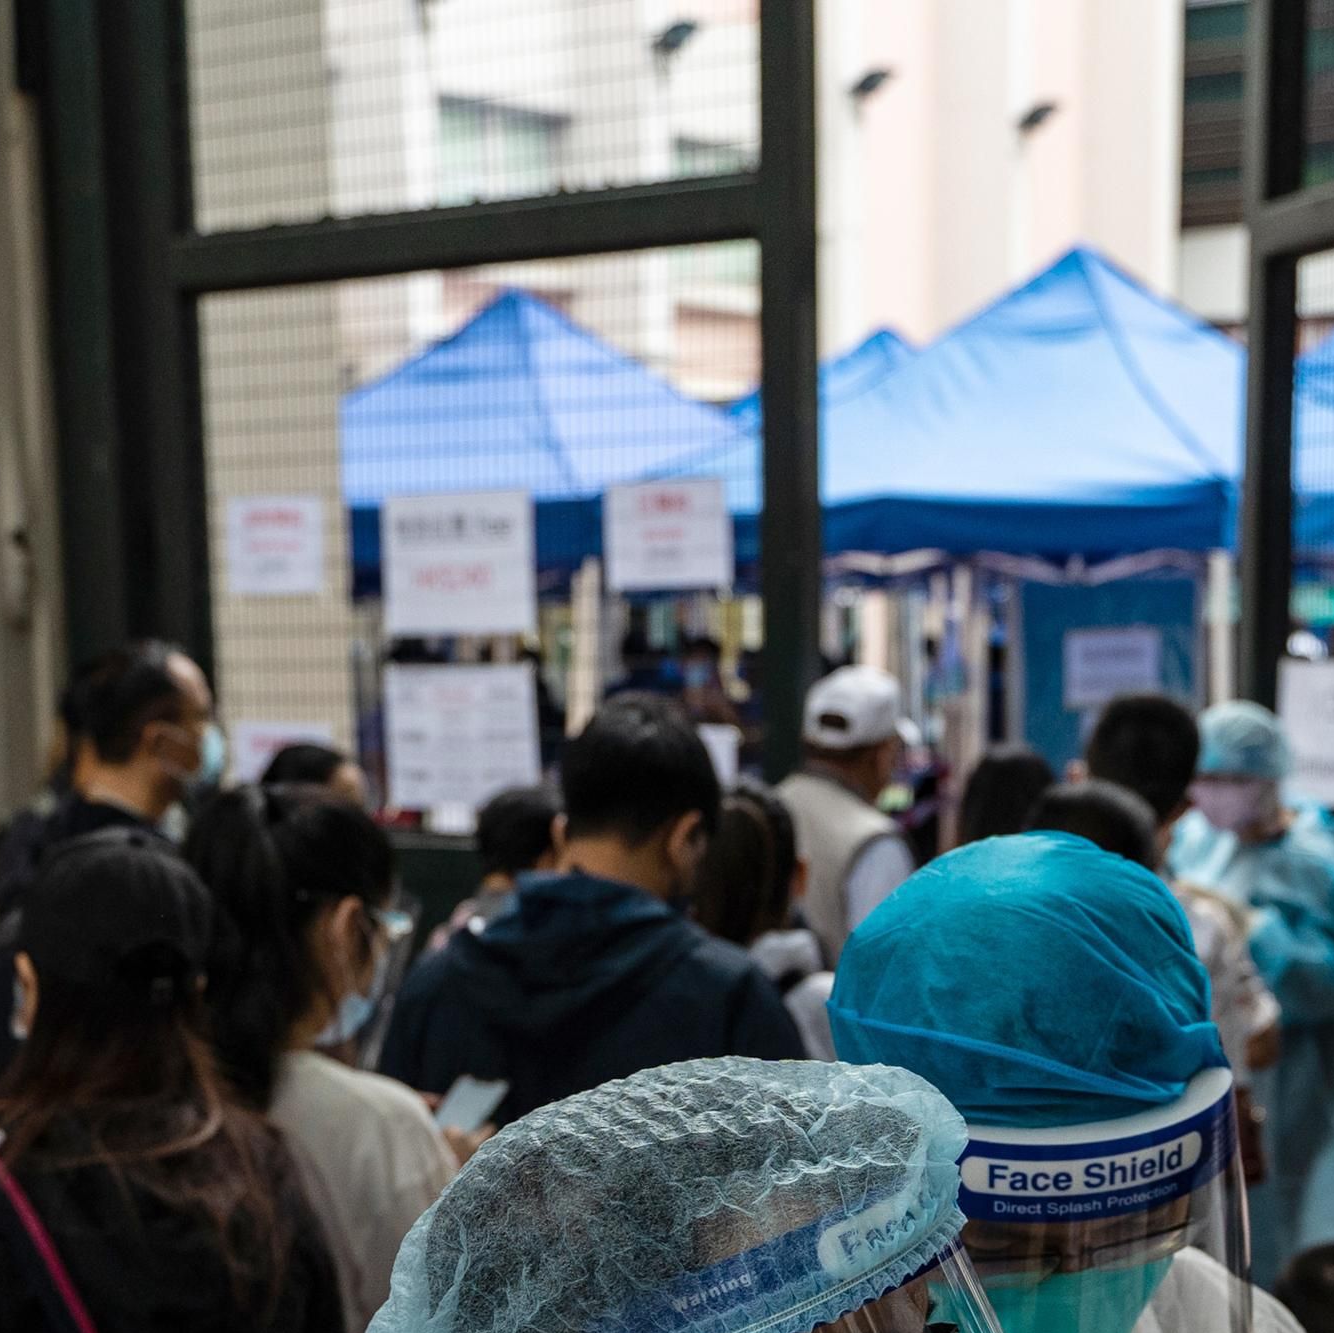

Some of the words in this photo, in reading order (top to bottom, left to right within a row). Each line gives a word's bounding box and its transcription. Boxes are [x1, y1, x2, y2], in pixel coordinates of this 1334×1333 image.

[987, 1162, 1073, 1192] Face
[1083, 1142, 1184, 1190] Shield
[993, 1200, 1043, 1216] Direct
[1047, 1199, 1103, 1216] Splash
[1106, 1181, 1179, 1210] Protection
[670, 1268, 758, 1315] Warning:
